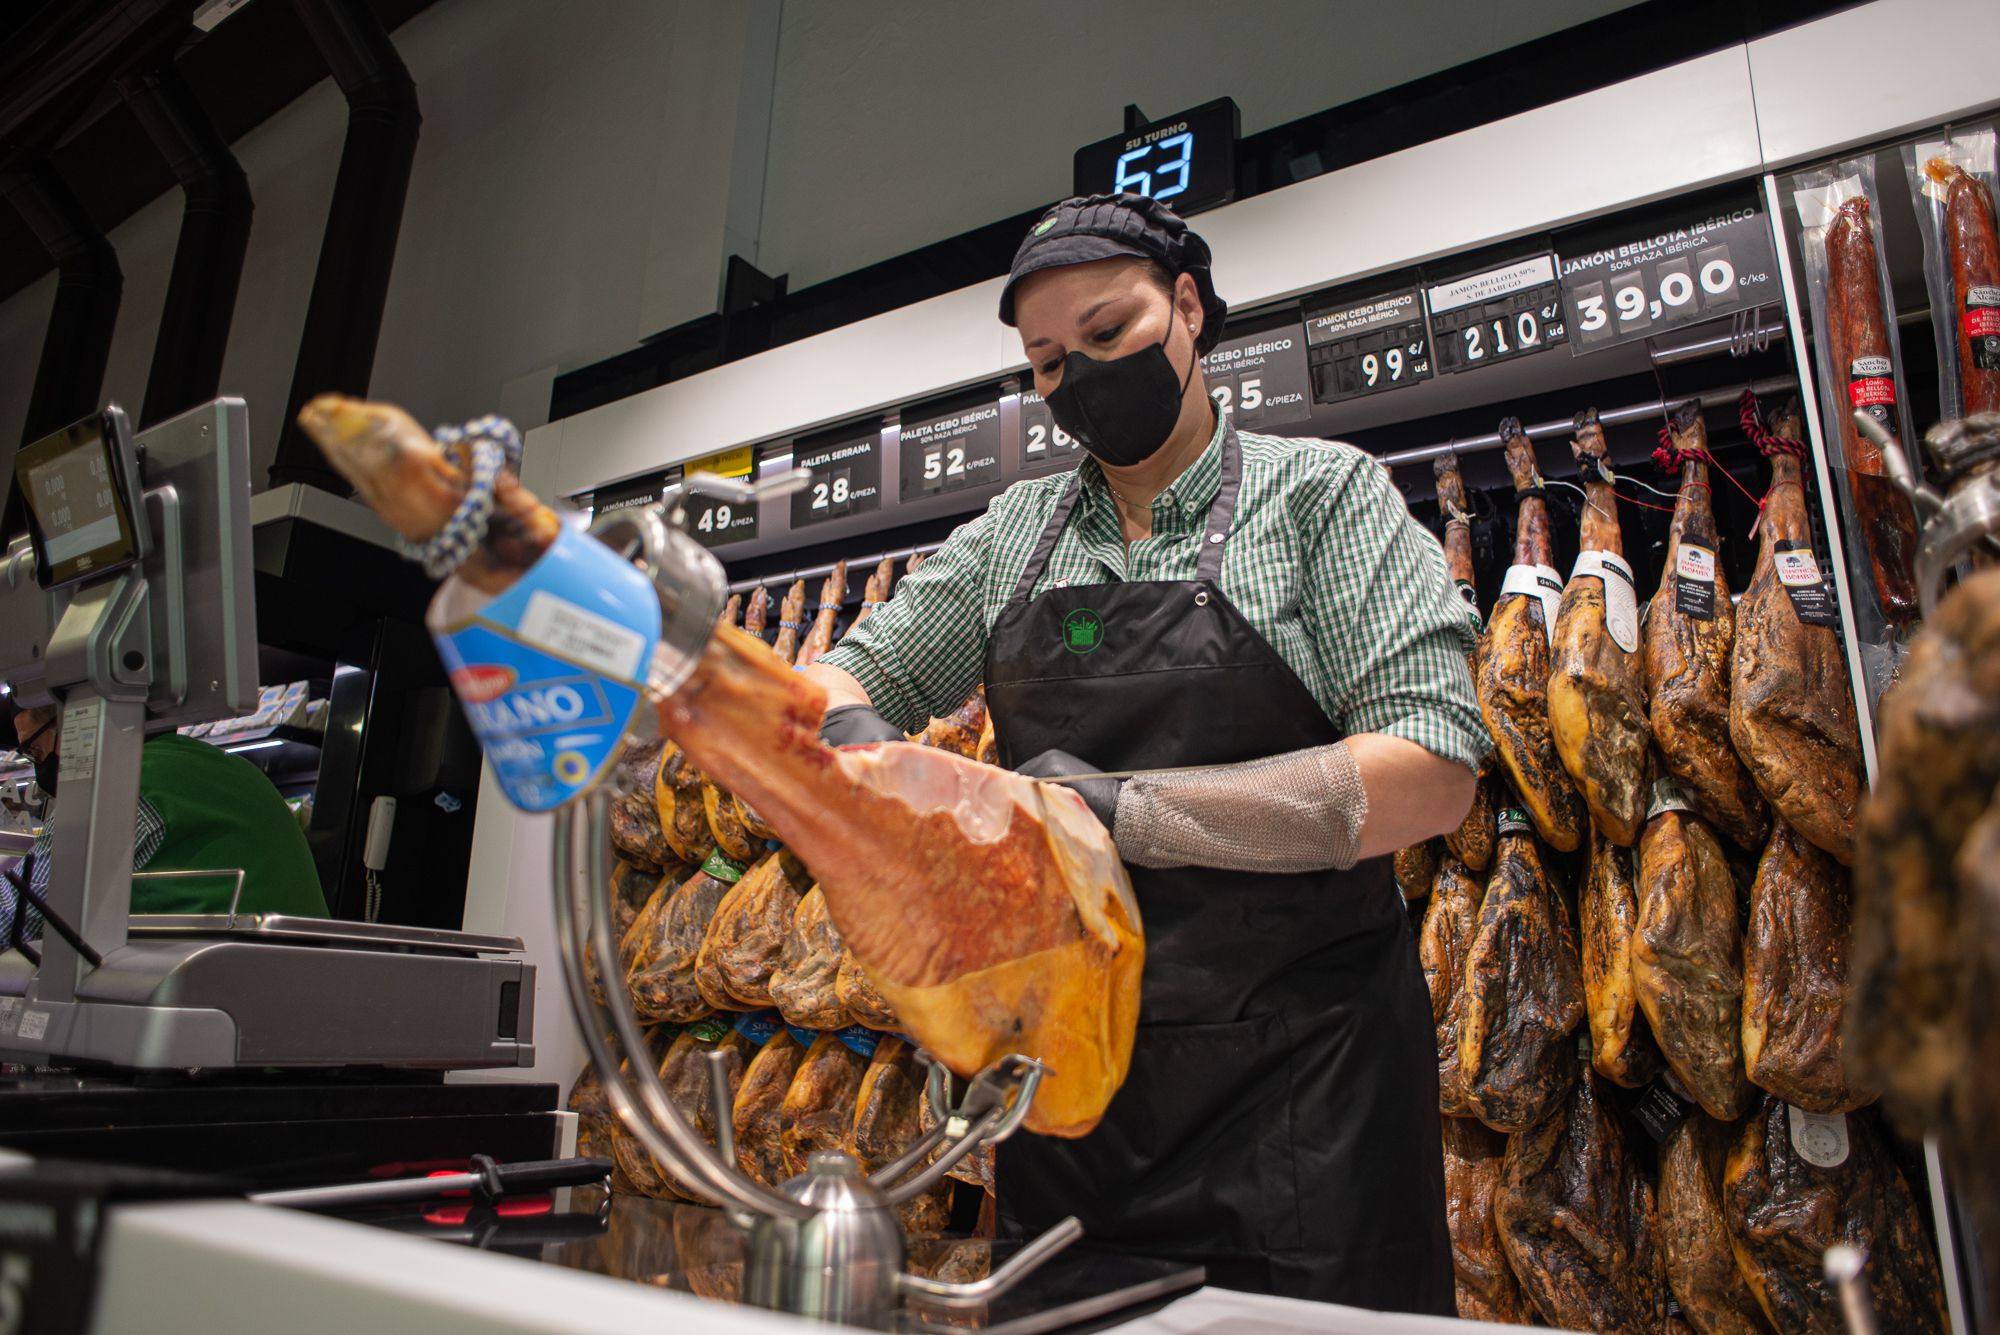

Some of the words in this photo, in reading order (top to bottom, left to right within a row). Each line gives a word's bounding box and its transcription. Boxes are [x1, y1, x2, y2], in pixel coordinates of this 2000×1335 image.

[1125, 138, 1141, 151] SU
[1144, 121, 1188, 144] TURNO
[1563, 249, 1616, 275] JAMÓN
[1618, 228, 1687, 258] BELLOTA
[1690, 207, 1755, 235] IBÉRICO
[1610, 258, 1632, 272] 50%
[1633, 249, 1664, 265] RAZA
[1665, 235, 1708, 255] IBÉRICA
[1475, 290, 1486, 298] DE
[1488, 281, 1521, 294] JABUGO
[1480, 272, 1517, 287] BELLOTA
[1577, 260, 1735, 331] 39,00
[1330, 324, 1347, 333] 50%
[1347, 317, 1367, 329] RAZA
[1349, 305, 1374, 319] CEBO
[1465, 312, 1537, 360] 210
[1549, 324, 1564, 337] ud
[1210, 349, 1242, 364] CEBO
[1244, 339, 1292, 357] IBÉRICO
[1210, 363, 1232, 373] RAZA
[1233, 356, 1266, 369] IBÉRICA
[1362, 349, 1403, 387] 99
[1415, 361, 1429, 373] ud
[900, 426, 933, 441] PALETA
[934, 418, 960, 432] CEBO
[961, 408, 998, 425] IBÉRICA
[934, 431, 951, 440] RAZA
[801, 454, 831, 468] PALETA
[831, 442, 871, 461] SERRANA
[924, 448, 965, 479] 52
[812, 478, 849, 510] 28
[698, 505, 732, 533] 49
